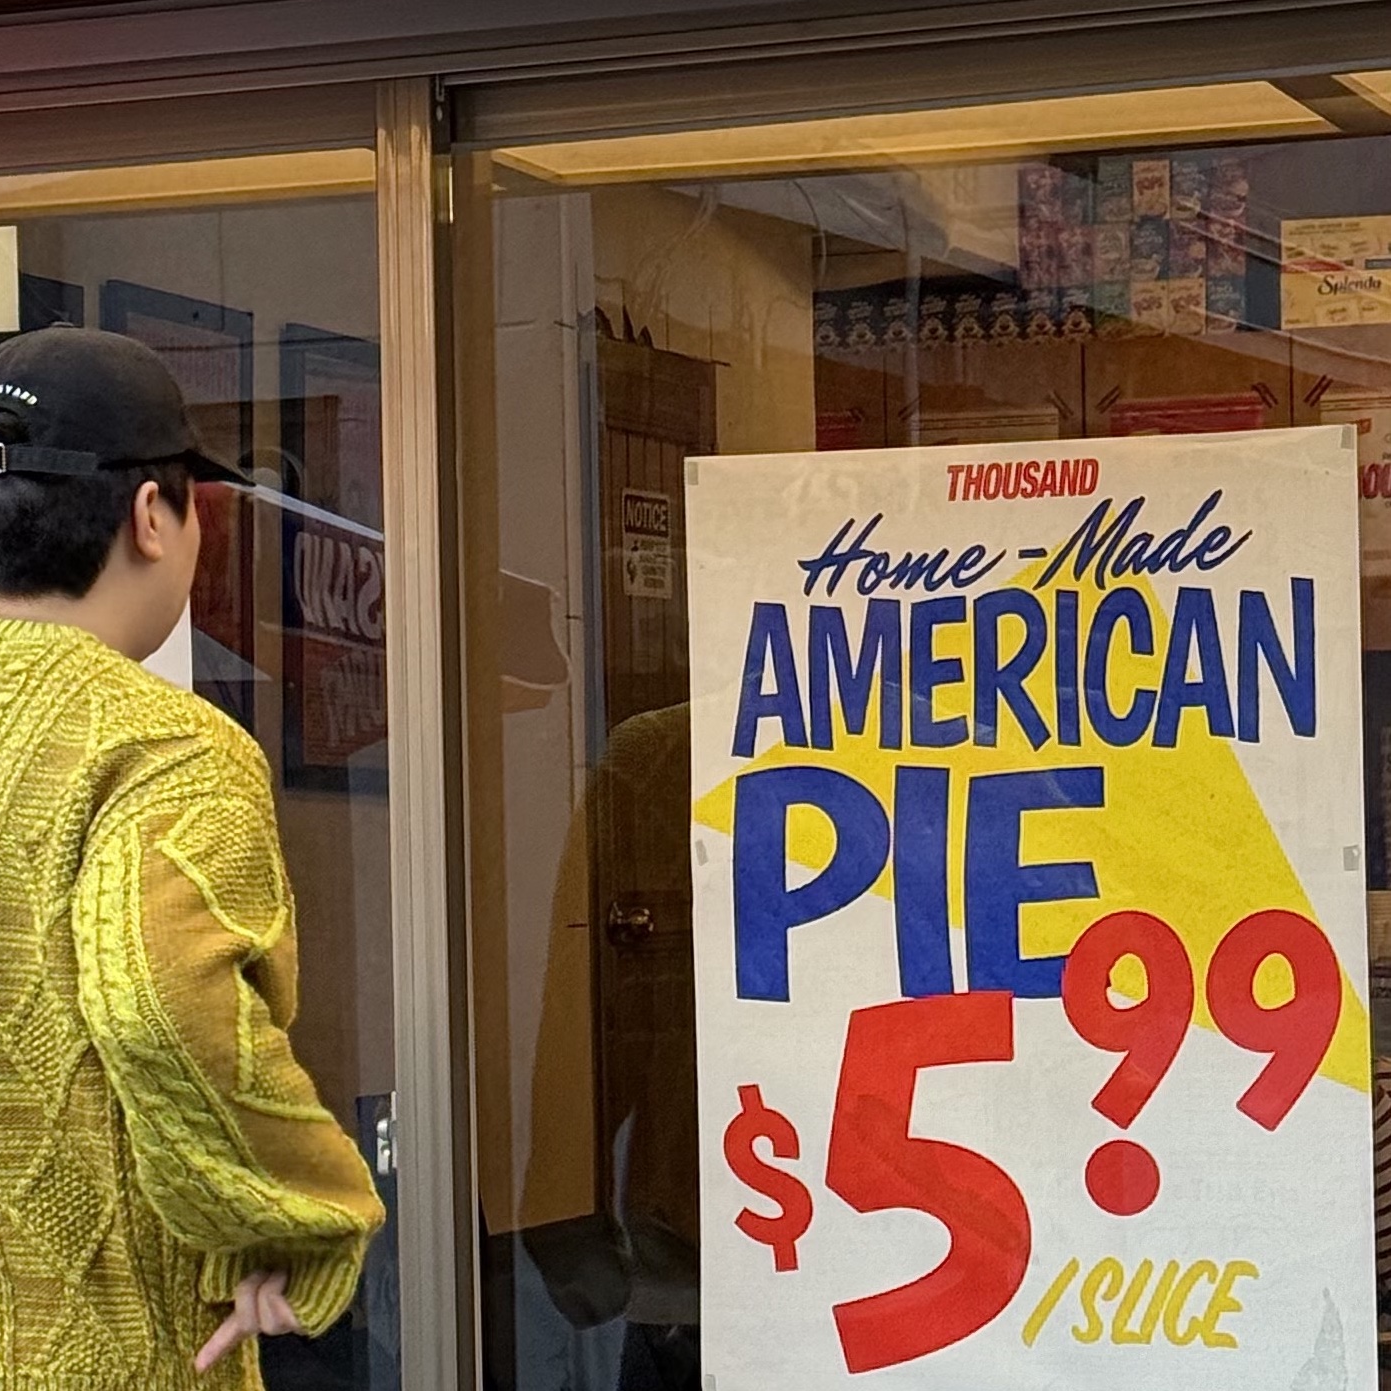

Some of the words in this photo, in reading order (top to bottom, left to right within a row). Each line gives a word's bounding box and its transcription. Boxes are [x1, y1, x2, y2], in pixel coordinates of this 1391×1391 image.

[1317, 274, 1382, 296] Splenda
[947, 459, 1099, 501] THOUSAND
[626, 499, 667, 531] NOTICE
[731, 577, 1316, 757] AMERICAN
[732, 764, 1104, 1002] PIE
